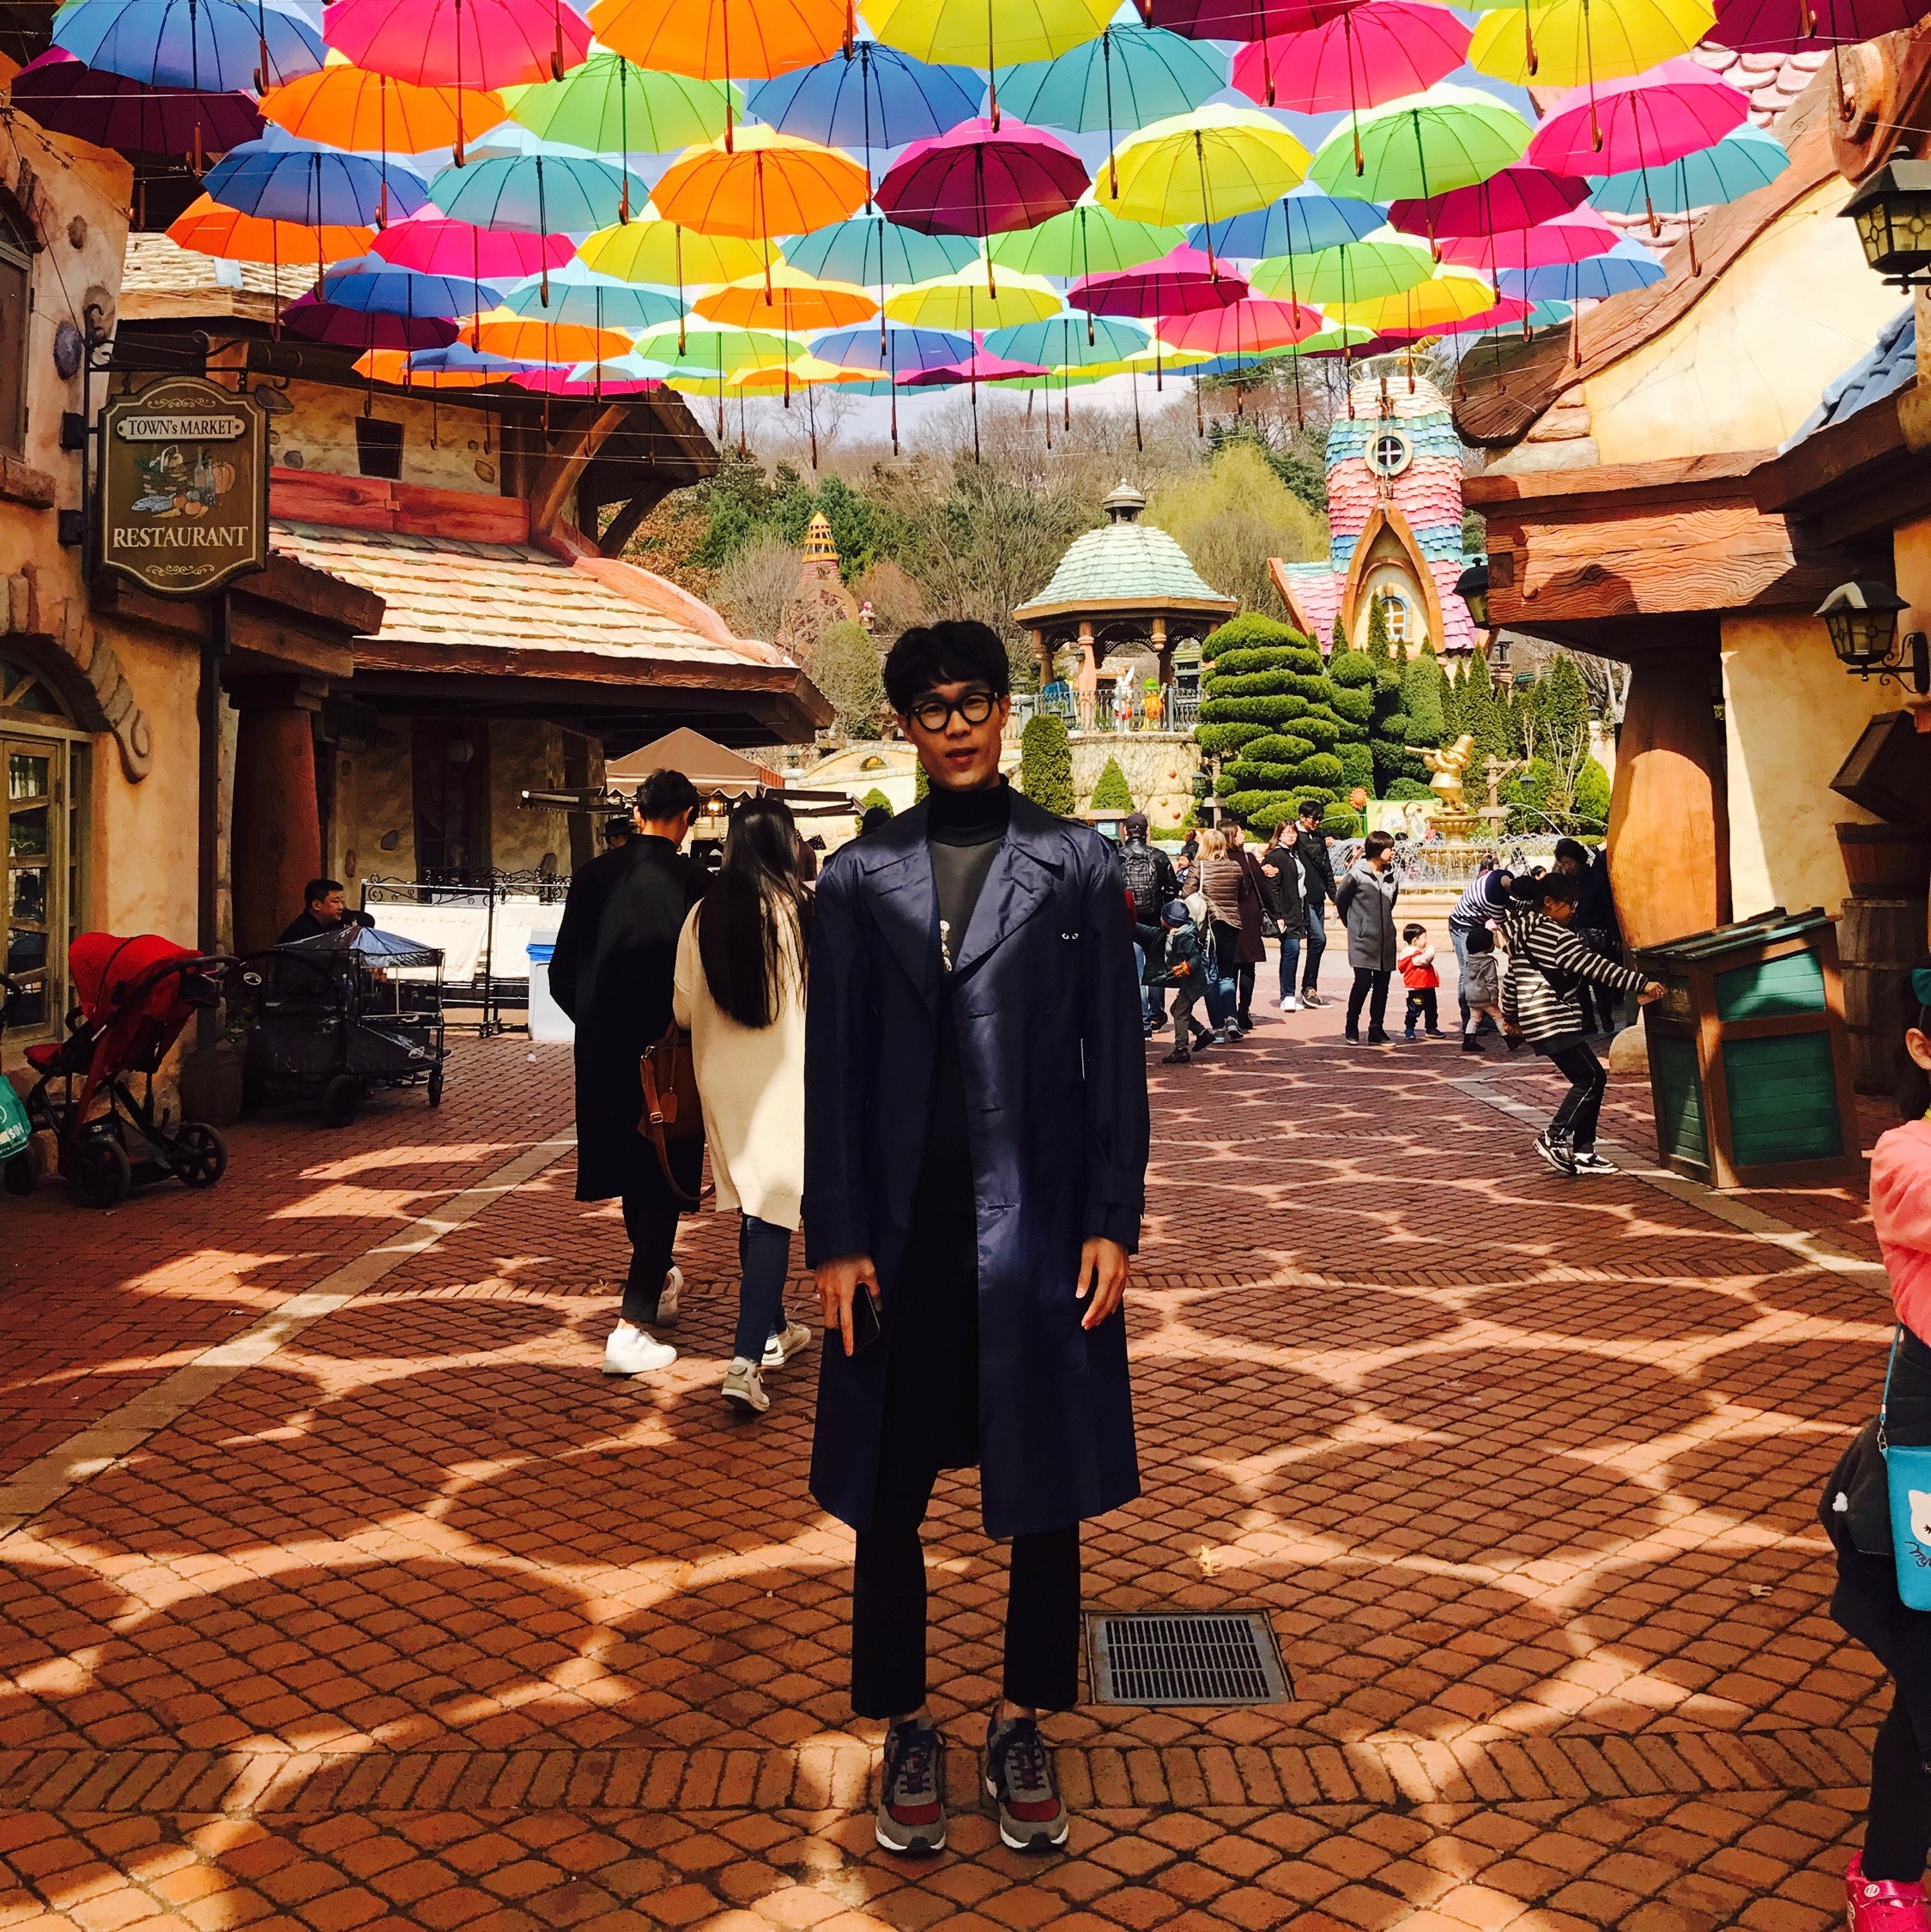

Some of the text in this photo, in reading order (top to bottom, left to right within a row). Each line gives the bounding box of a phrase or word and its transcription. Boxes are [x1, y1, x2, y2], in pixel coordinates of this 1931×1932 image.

[129, 419, 234, 435] TOWN's MARKET
[112, 526, 248, 548] RESTAURANT
